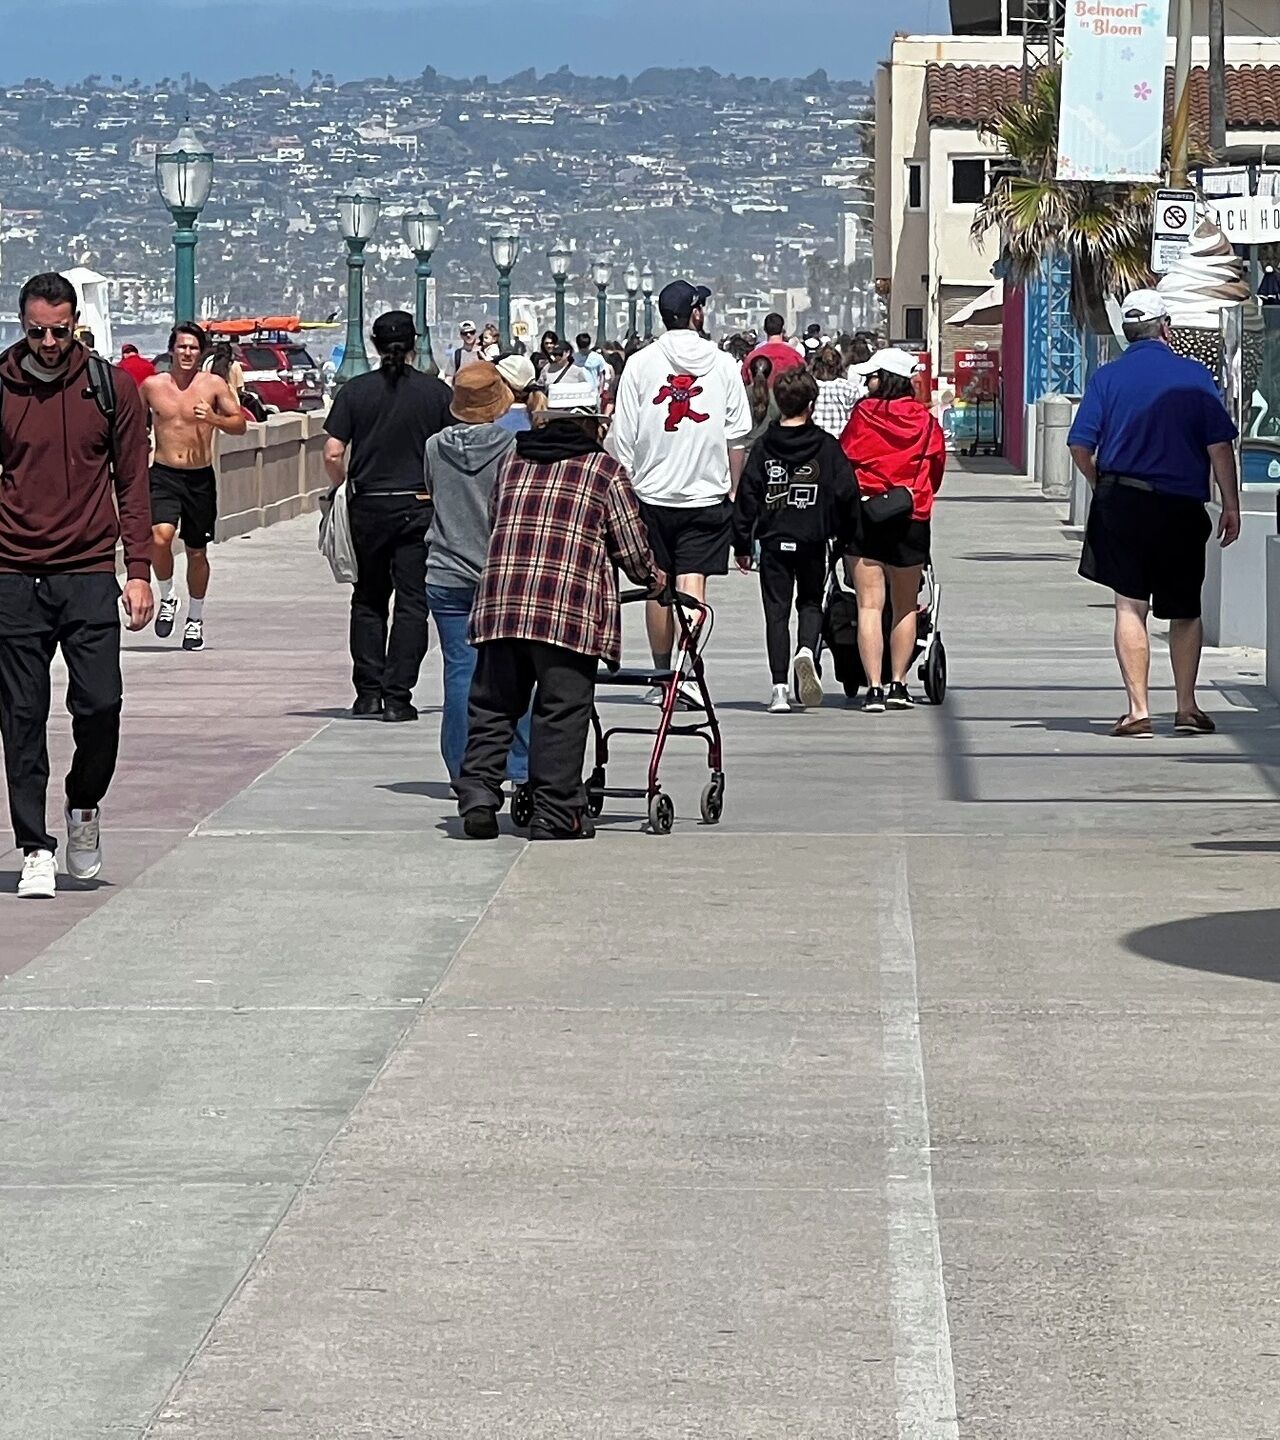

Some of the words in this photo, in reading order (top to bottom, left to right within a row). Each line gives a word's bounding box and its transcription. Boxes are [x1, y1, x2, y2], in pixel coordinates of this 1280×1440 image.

[1075, 0, 1148, 17] Belmont
[1080, 20, 1089, 28] in
[1093, 20, 1142, 35] Bloom
